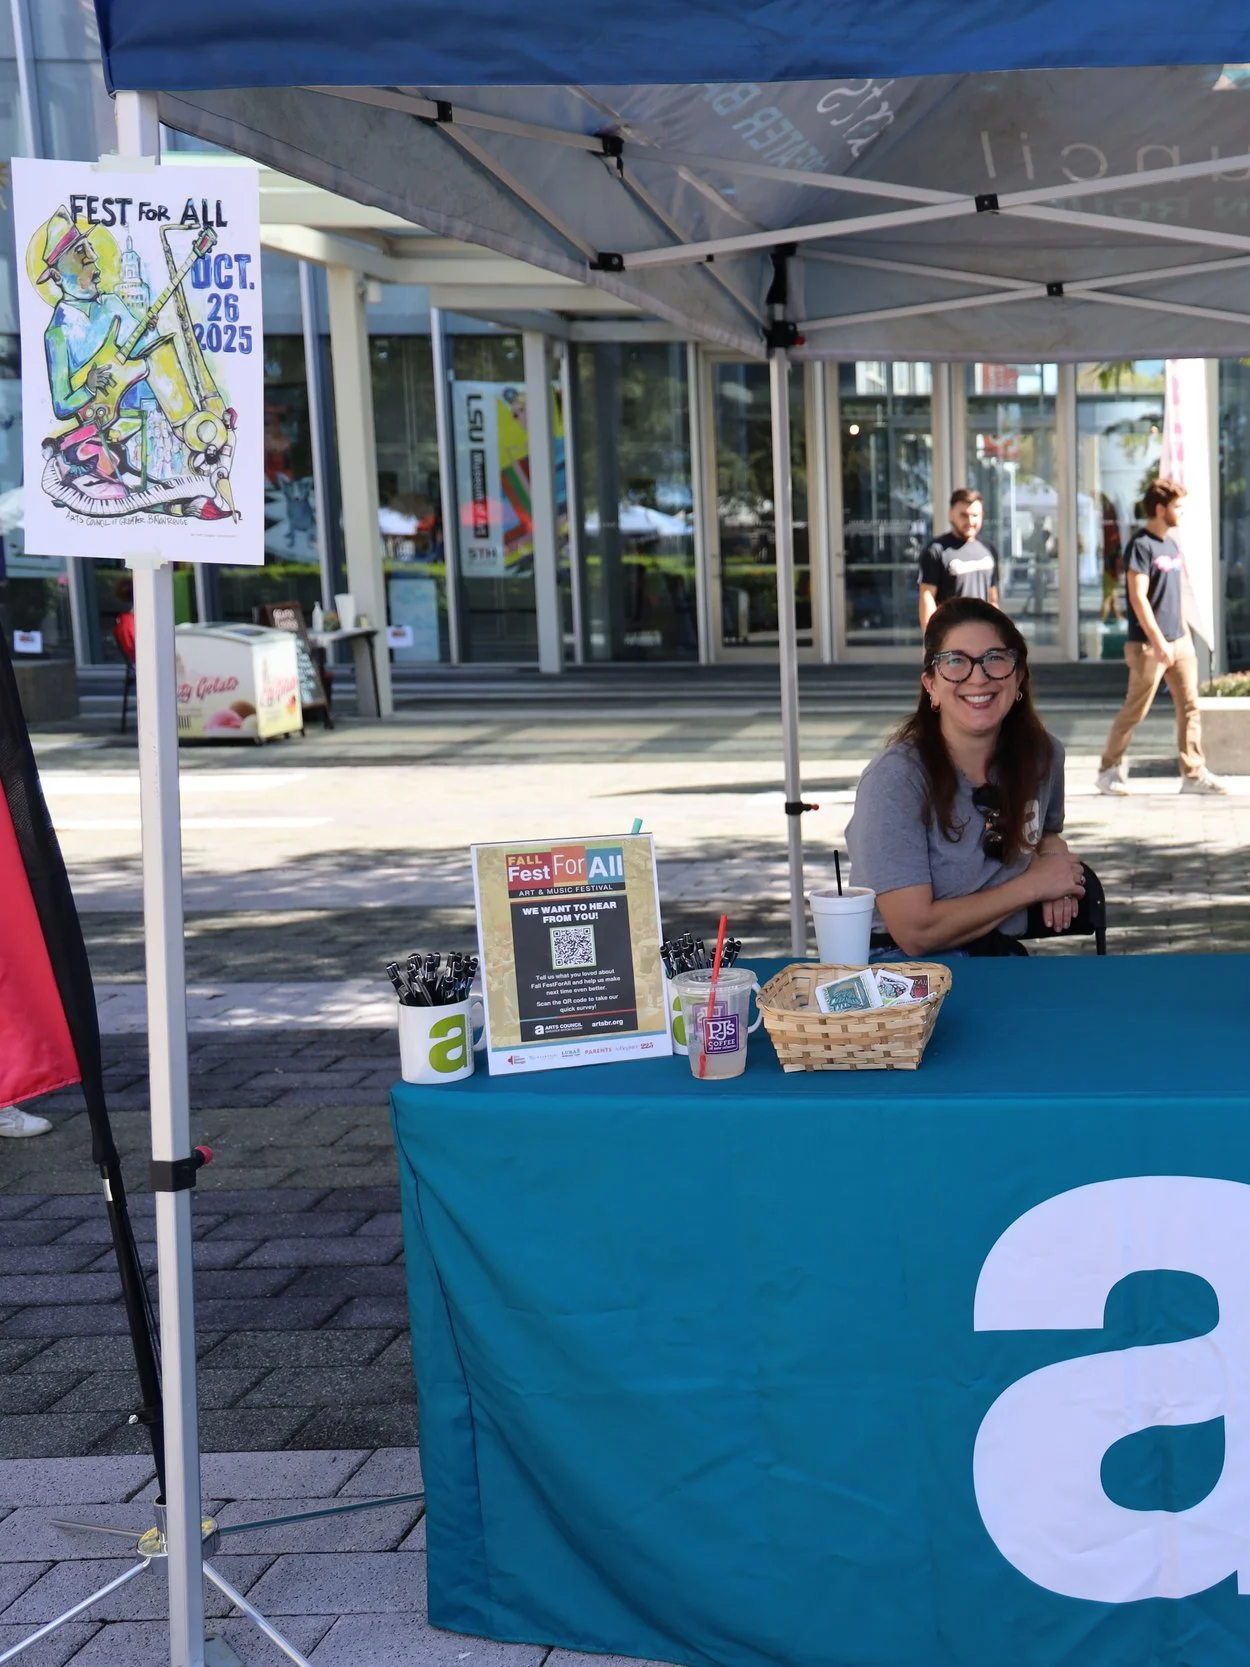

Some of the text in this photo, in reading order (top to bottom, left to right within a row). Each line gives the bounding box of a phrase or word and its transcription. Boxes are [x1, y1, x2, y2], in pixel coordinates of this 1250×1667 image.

[70, 194, 132, 226] FEST
[181, 198, 228, 228] ALL
[207, 293, 240, 323] 26
[194, 325, 253, 354] 2025
[467, 394, 484, 442] LSU
[508, 855, 542, 866] FALL
[508, 854, 623, 882] Fest For All
[546, 886, 573, 895] MUSIC
[576, 884, 613, 892] FESTIVAL
[522, 902, 617, 916] WE WANT TO HEAR
[543, 912, 599, 924] FROM YOU!
[429, 1014, 468, 1073] a
